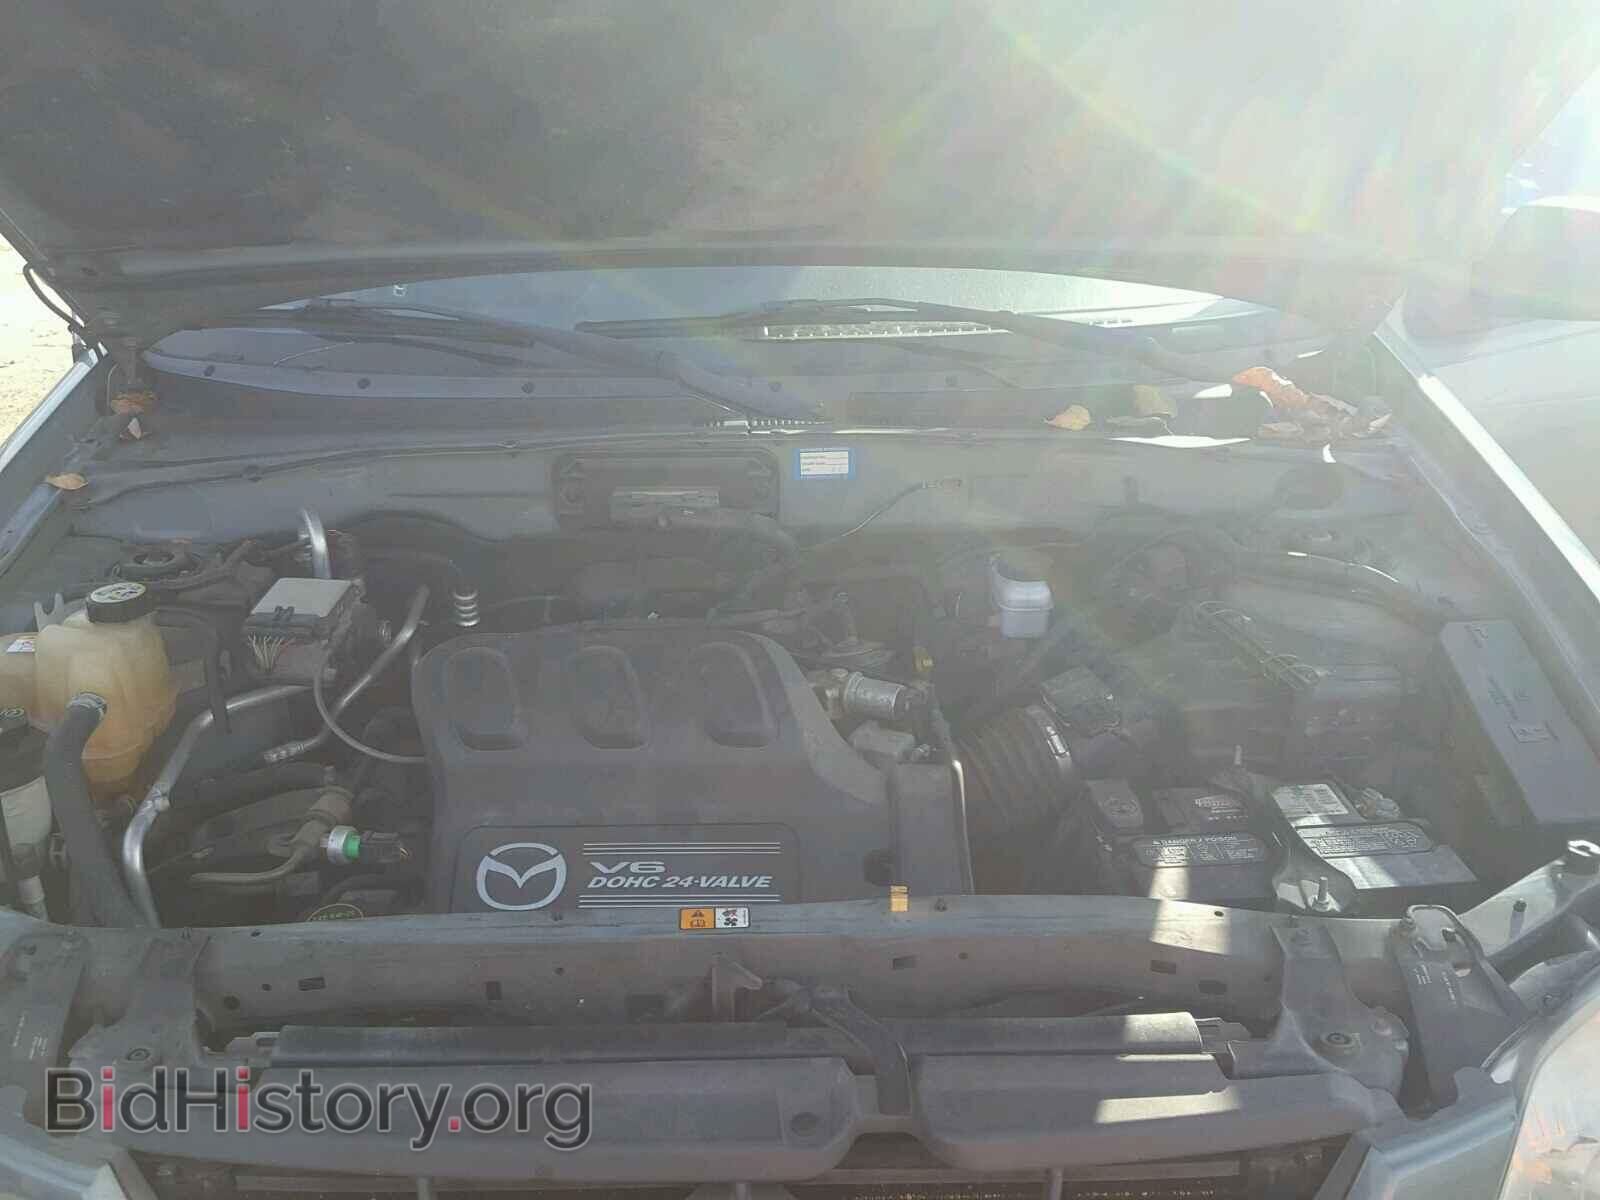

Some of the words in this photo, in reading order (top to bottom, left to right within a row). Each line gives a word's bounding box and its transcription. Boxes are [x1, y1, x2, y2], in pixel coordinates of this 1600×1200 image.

[590, 861, 665, 874] V6
[587, 876, 660, 888] DOHC
[662, 876, 772, 888] 24-VALVE
